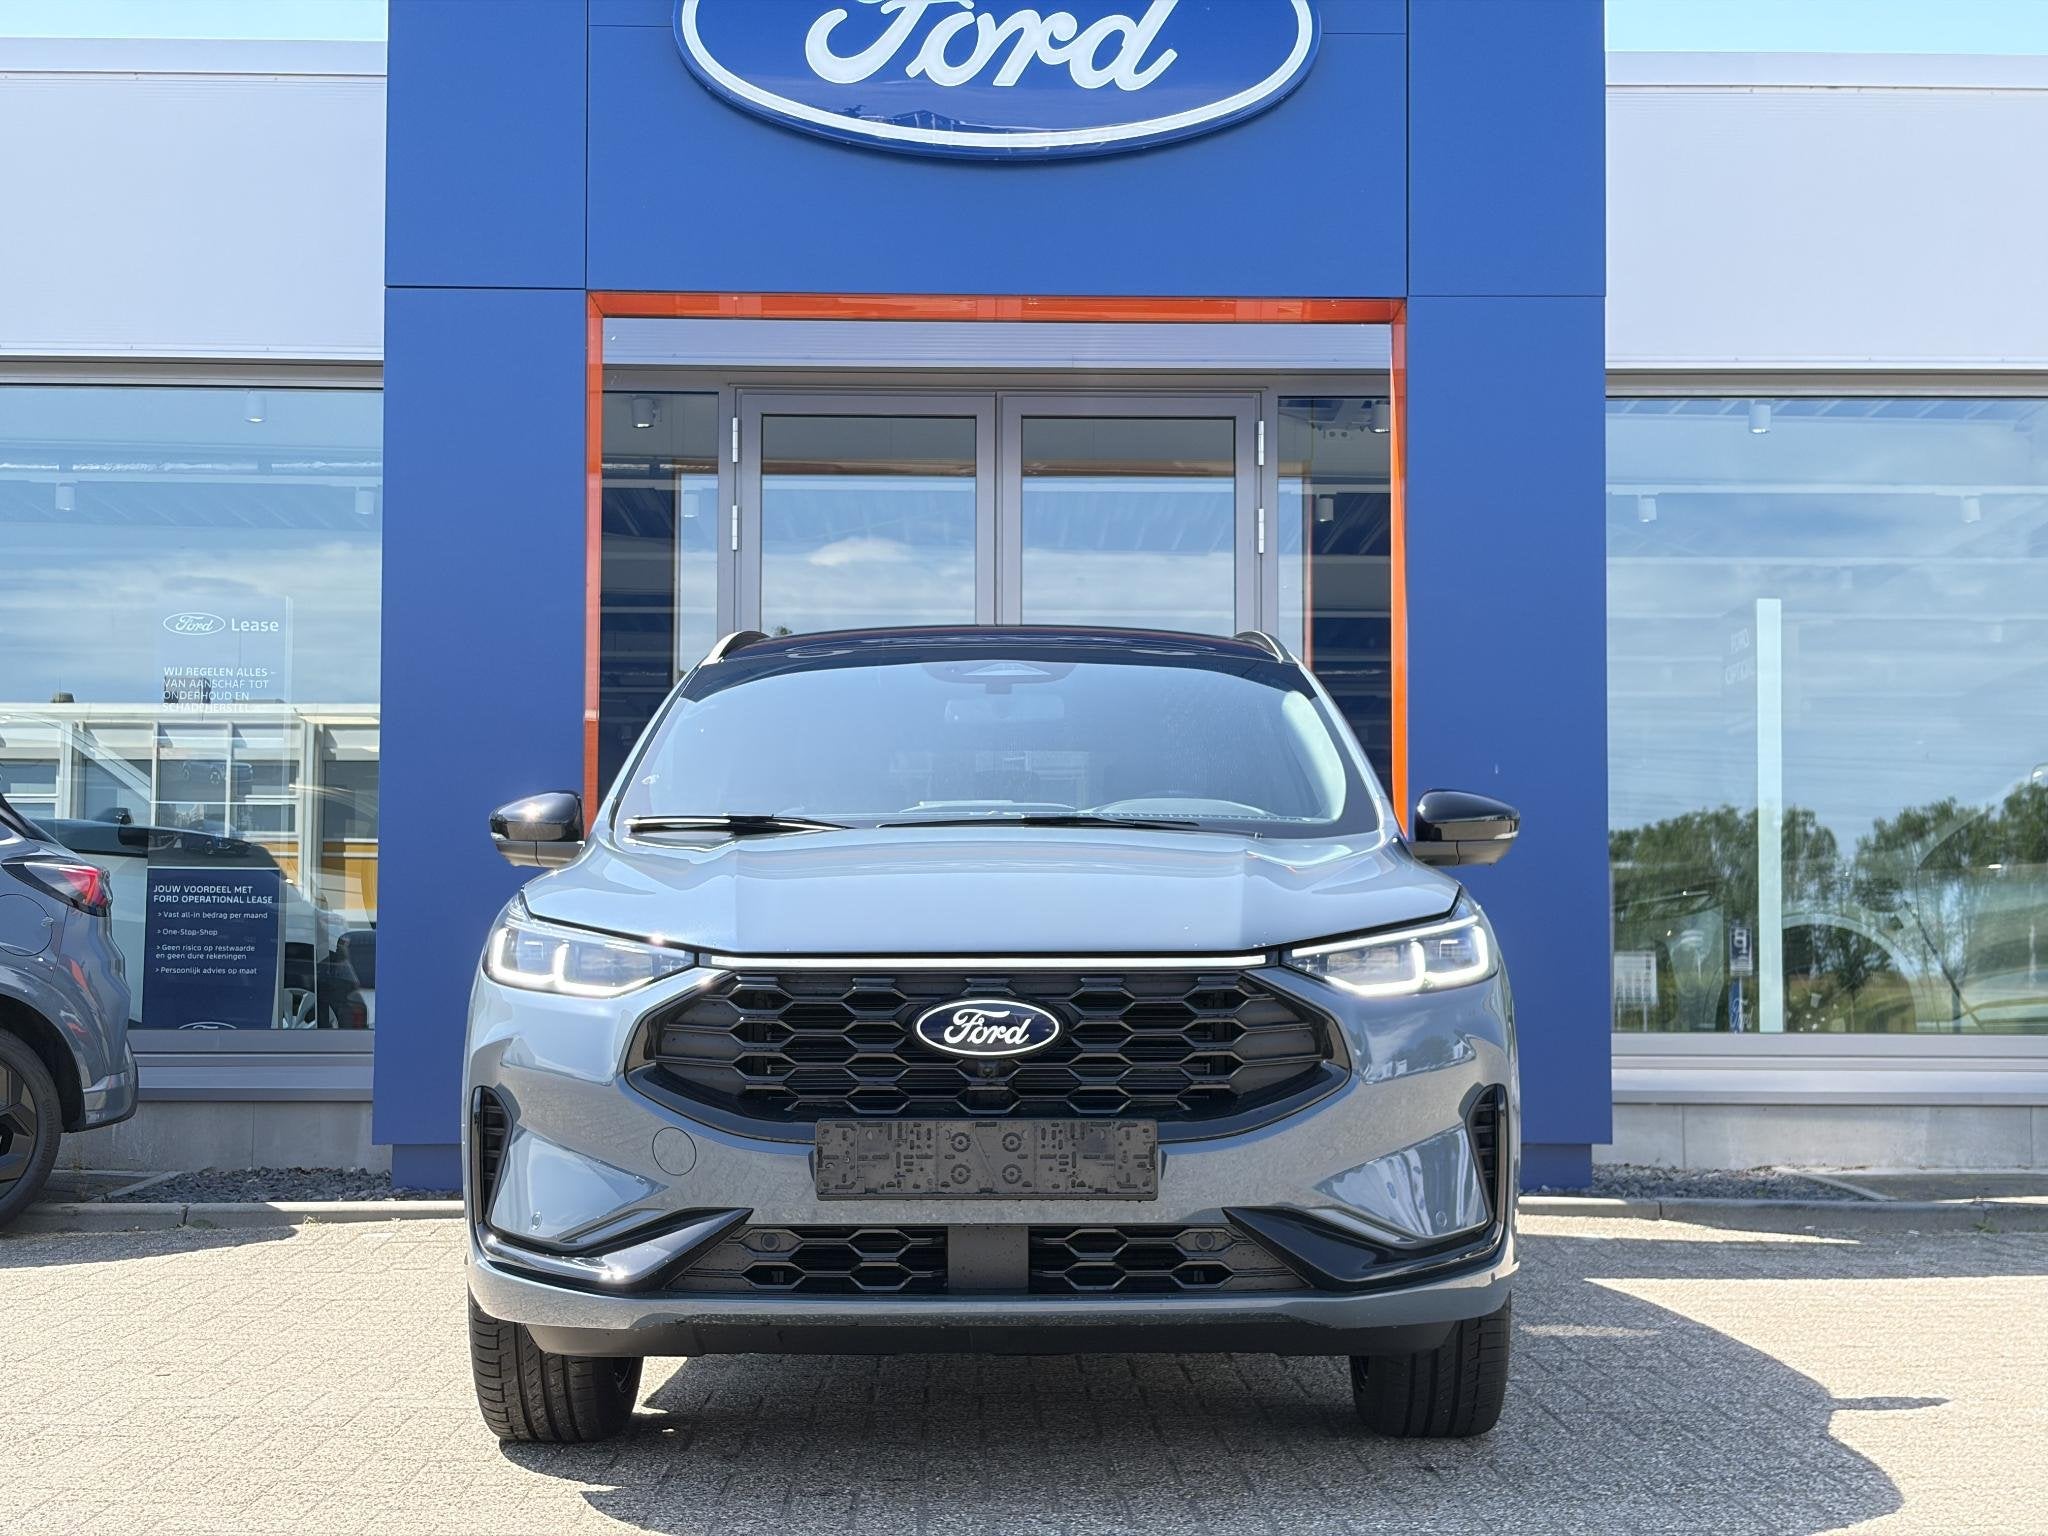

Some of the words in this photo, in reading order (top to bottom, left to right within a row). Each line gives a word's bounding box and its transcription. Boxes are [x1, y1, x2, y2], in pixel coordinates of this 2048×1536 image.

[805, 0, 1178, 91] Ford
[231, 617, 280, 632] Lease
[163, 666, 183, 677] WIJ
[186, 666, 234, 677] REGELEN
[236, 667, 269, 677] ALLES
[163, 678, 186, 689] VAN
[189, 678, 246, 689] AANSCHAF
[249, 679, 269, 690] TOT
[163, 690, 232, 701] ONDERHOUD
[235, 690, 249, 701] EN
[153, 884, 181, 893] JOUW
[183, 885, 232, 894] VOORDEEL
[234, 885, 254, 894] MET
[153, 894, 179, 903] FORD
[181, 895, 244, 904] OPERATIONAL
[246, 895, 273, 904] LEASE
[162, 911, 179, 919] Vast
[181, 911, 200, 919] all-in
[202, 911, 228, 920] bedrag
[229, 912, 241, 920] per
[162, 928, 218, 937] One-Stop-Shop
[203, 945, 214, 953] op
[215, 944, 255, 952] restwaarde
[187, 952, 205, 960] dure
[206, 952, 247, 961] rekeningen
[160, 966, 200, 975] Persoonlijk
[202, 966, 226, 974] advies
[239, 967, 257, 975] maat
[943, 1008, 1032, 1045] Ford
